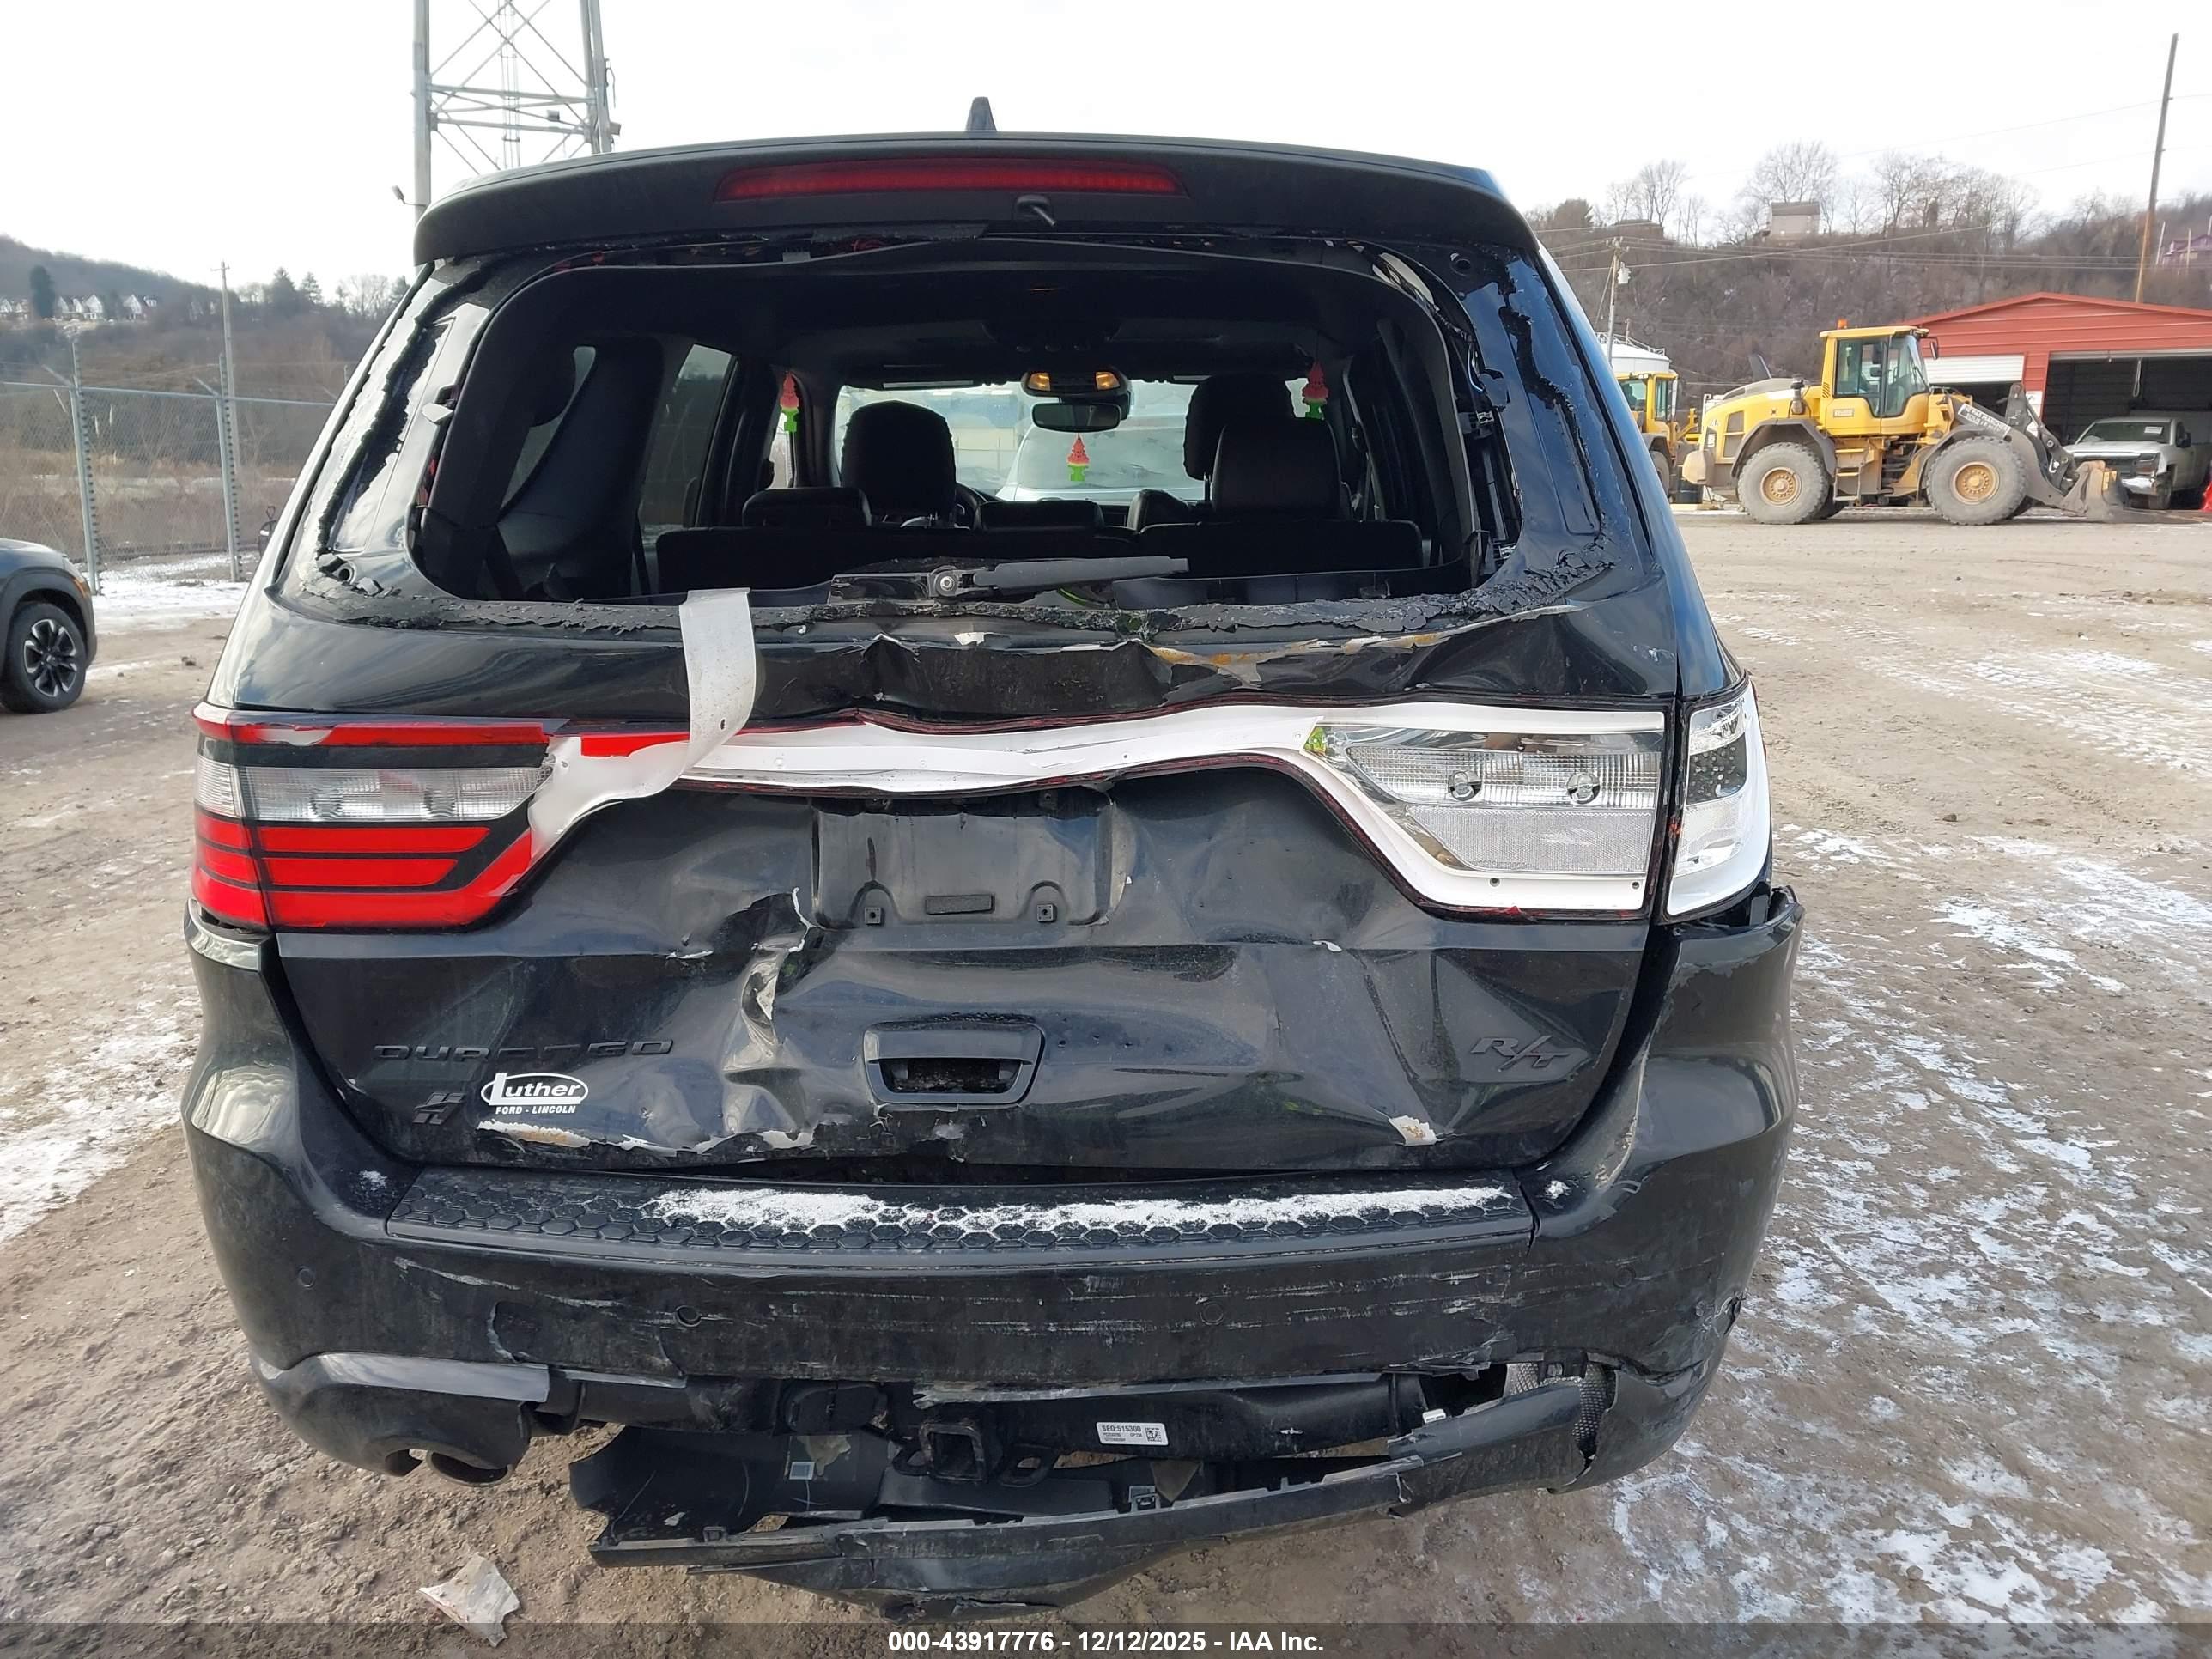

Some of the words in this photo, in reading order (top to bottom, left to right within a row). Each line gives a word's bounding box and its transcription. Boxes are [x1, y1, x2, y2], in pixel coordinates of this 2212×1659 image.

[374, 1039, 673, 1061] DURANGO
[1470, 1035, 1570, 1072] R/T
[489, 1073, 582, 1105] Luther
[495, 1106, 523, 1115] FORD
[532, 1105, 576, 1114] LINCOLN
